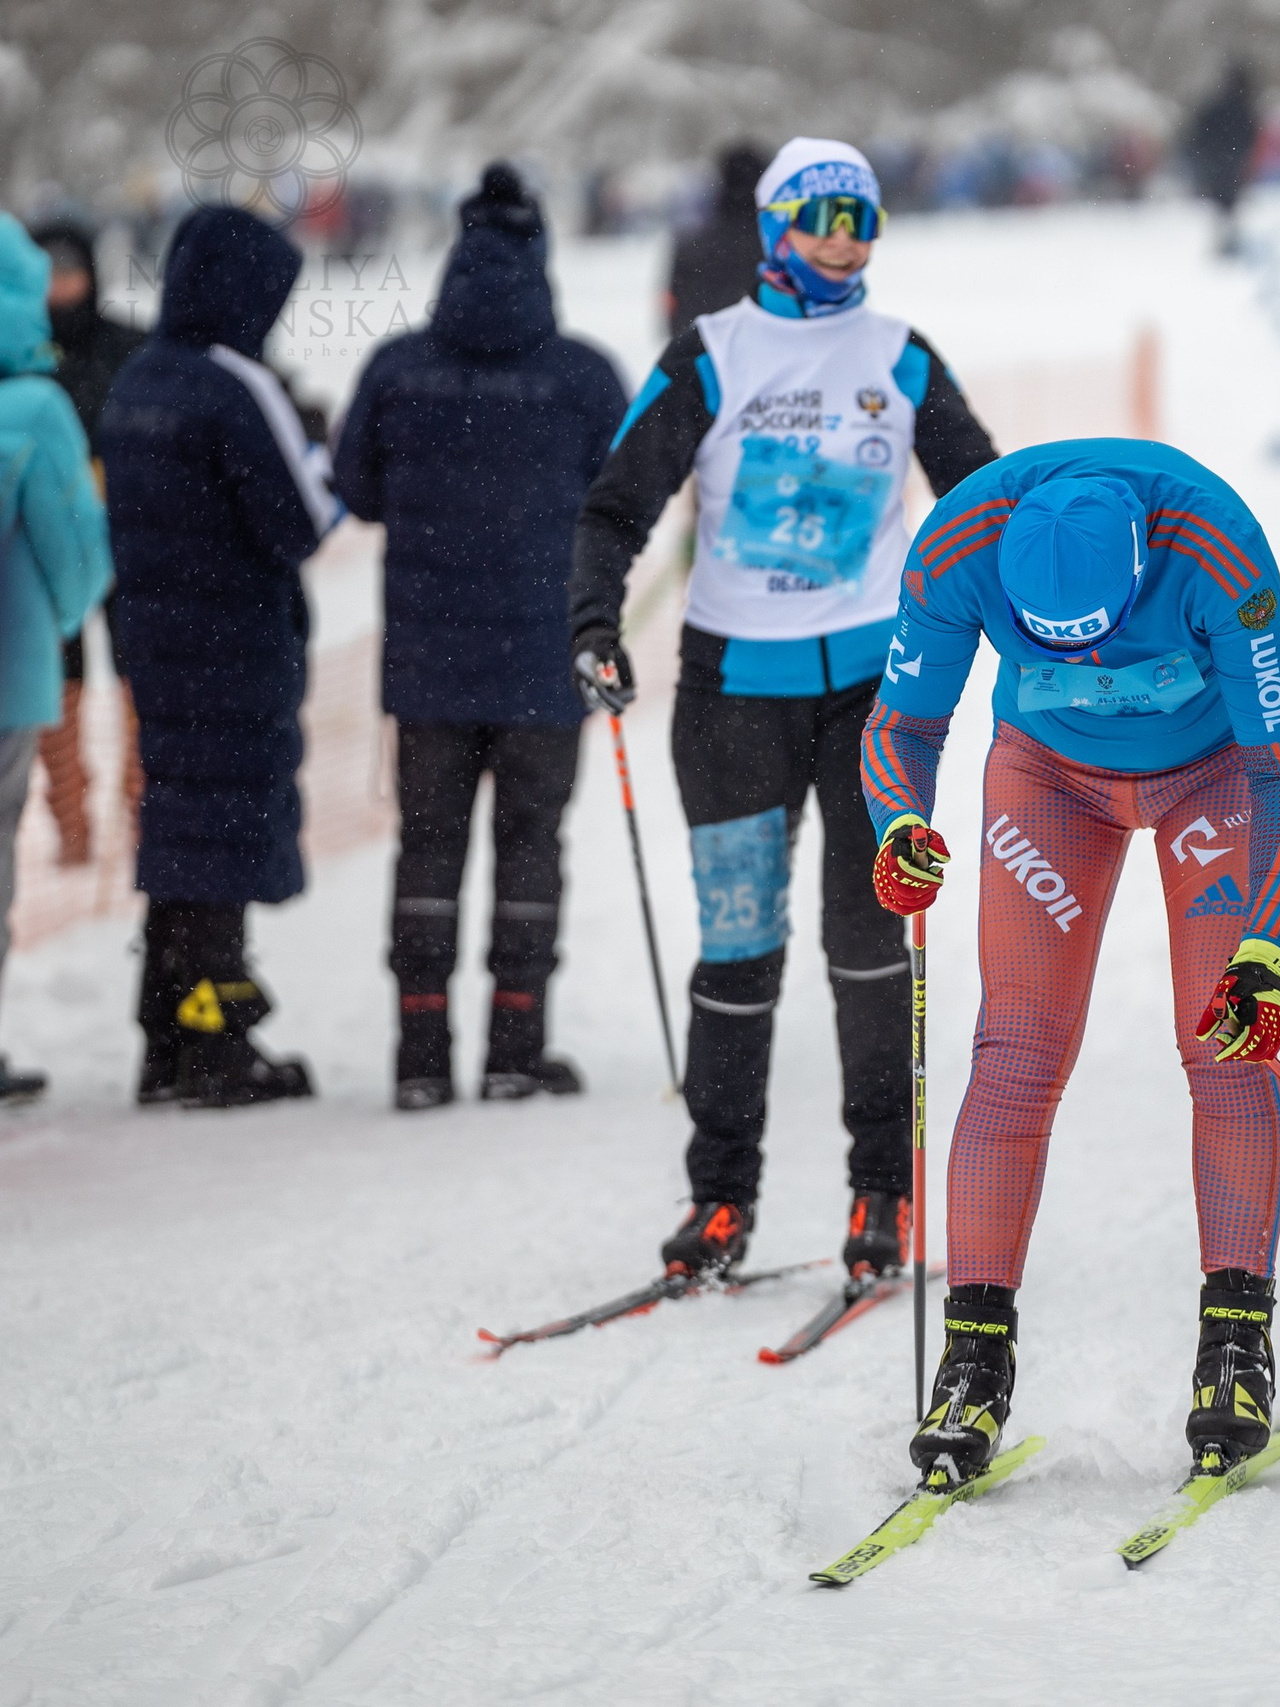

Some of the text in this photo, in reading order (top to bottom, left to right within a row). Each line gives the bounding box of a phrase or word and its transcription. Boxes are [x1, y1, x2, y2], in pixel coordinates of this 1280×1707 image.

[1029, 617, 1103, 638] DKB
[891, 872, 929, 889] LEKI
[986, 814, 1084, 933] LUKOIL
[709, 883, 760, 930] 25
[914, 978, 927, 1017] LEKI
[1233, 1034, 1261, 1060] LEKI
[1203, 1306, 1268, 1322] FISCHER
[945, 1318, 1008, 1335] FISCHER
